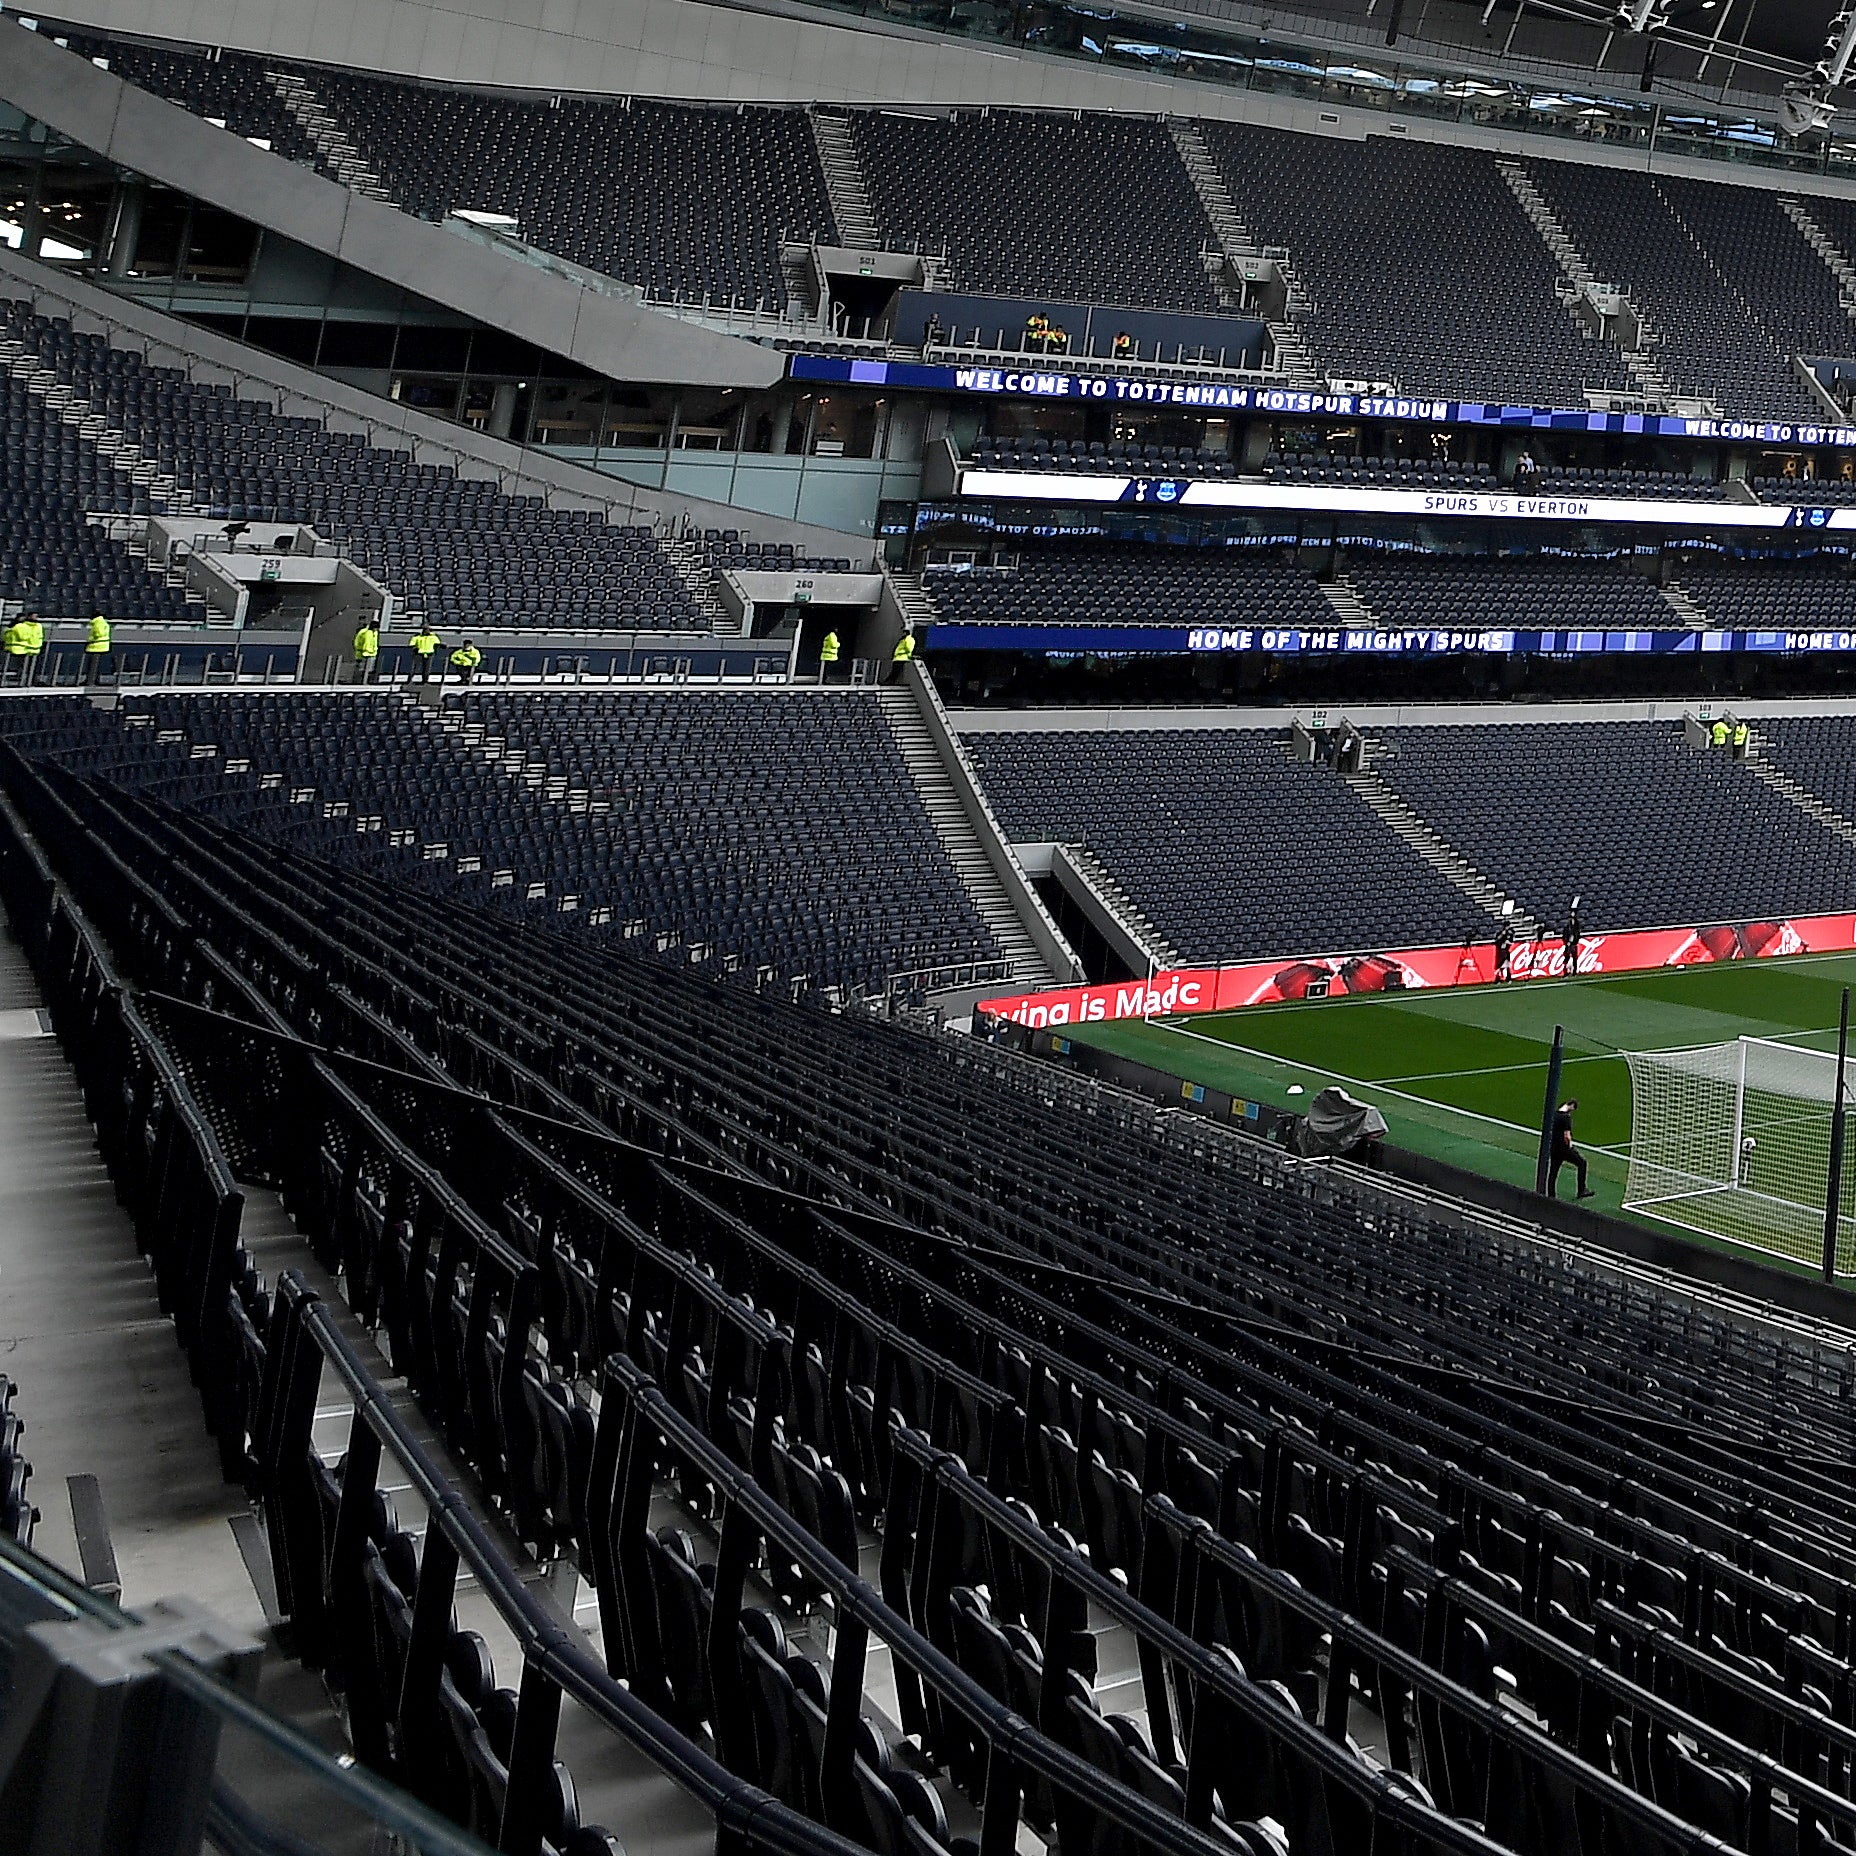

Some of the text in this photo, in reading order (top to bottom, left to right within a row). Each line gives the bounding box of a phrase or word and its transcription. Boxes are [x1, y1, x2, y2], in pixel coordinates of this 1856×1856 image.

[956, 370, 1448, 420] WELCOME TO TOTTENHAM HOTSPUR STADIUM
[1685, 420, 1765, 440] WELCOME
[1771, 425, 1792, 441] TO
[1424, 496, 1589, 516] SPURS VS EVERTON
[262, 559, 281, 569] 259
[796, 580, 814, 589] 260
[1188, 631, 1504, 650] HOME OF THE MIGHTY SPURS
[1785, 633, 1836, 650] HOME
[1313, 710, 1328, 718] 102
[1080, 992, 1107, 1024] is
